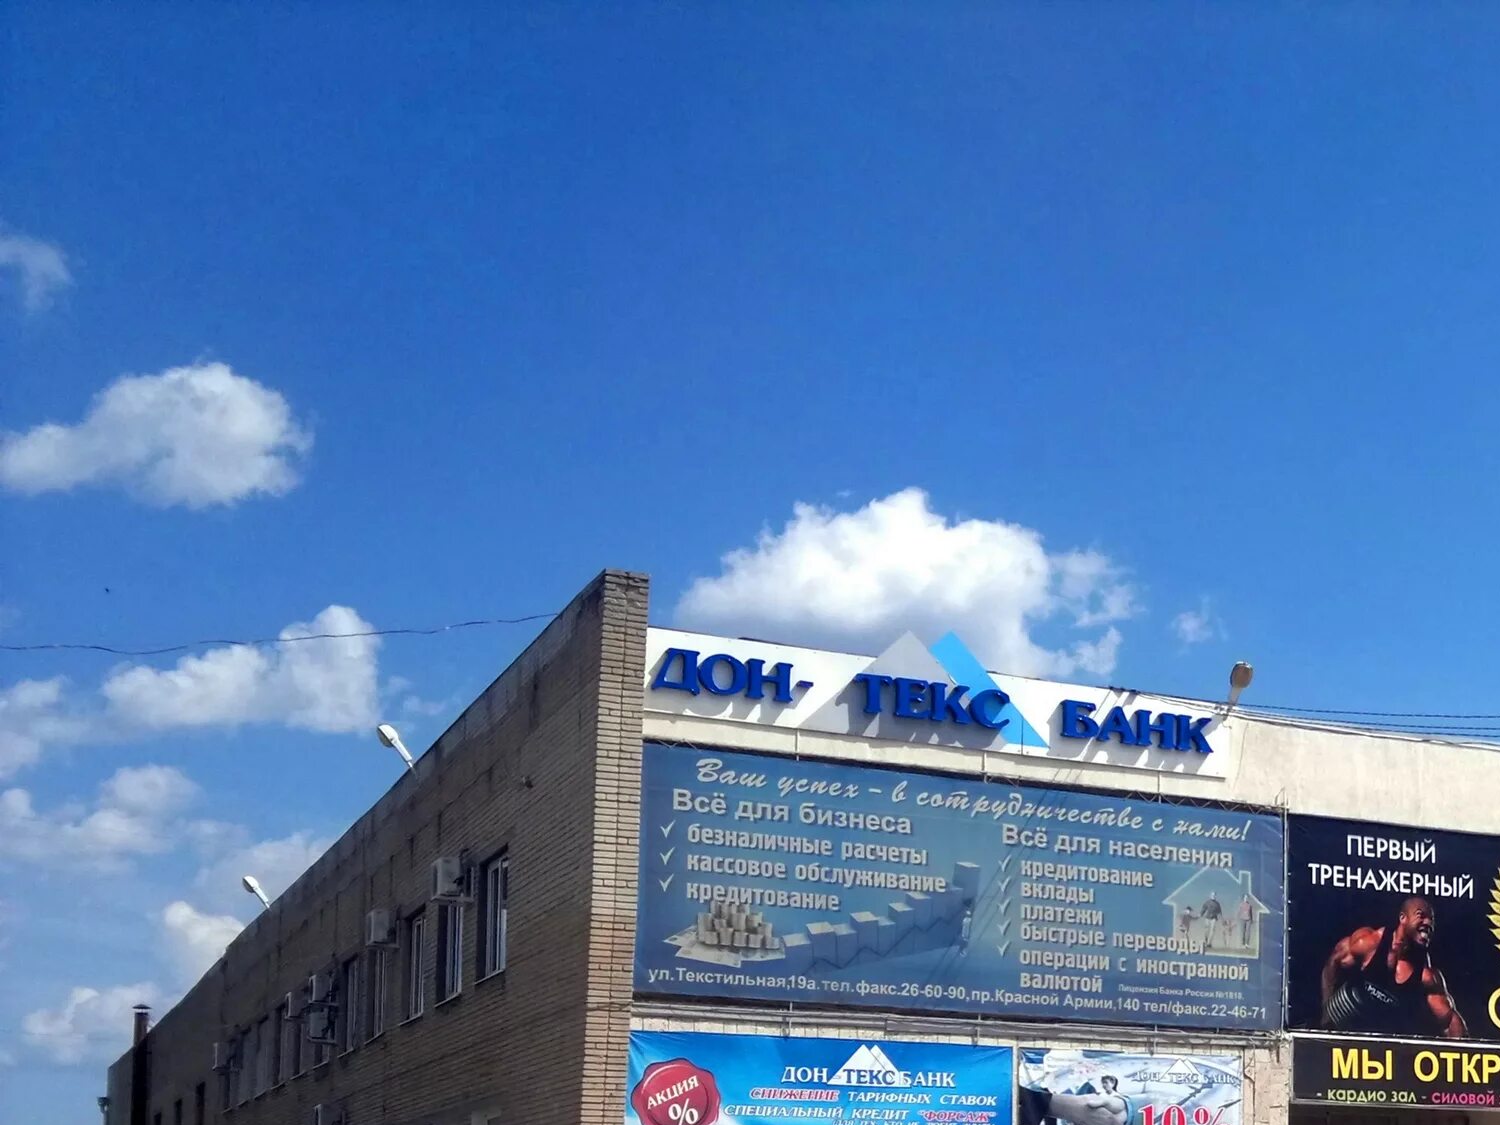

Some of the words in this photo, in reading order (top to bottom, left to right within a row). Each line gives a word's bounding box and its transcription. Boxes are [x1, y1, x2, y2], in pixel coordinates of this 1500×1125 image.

[652, 647, 812, 703] ДОН-
[855, 672, 1010, 731] ТЕКС
[1060, 699, 1214, 754] БАНК
[672, 788, 728, 816] Всё
[735, 800, 789, 822] для
[799, 802, 913, 835] бизнеса
[696, 758, 767, 788] Ваш
[777, 776, 859, 798] успех
[891, 780, 907, 803] в
[916, 790, 1143, 829] сотрудничестве
[1152, 818, 1165, 832] с
[1173, 820, 1253, 842] нами!
[687, 823, 832, 857] безналичные
[841, 840, 928, 866] расчеты
[1002, 823, 1048, 848] Всё
[1054, 833, 1101, 855] для
[1109, 839, 1234, 868] населения
[1347, 834, 1436, 864] ПЕРВЫЙ
[687, 853, 787, 878] кассовое
[795, 863, 947, 893] обслуживание
[1020, 859, 1153, 888] кредитование
[1308, 863, 1474, 899] ТРЕНАЖЕРНЫЙ
[686, 882, 840, 911] кредитование
[1020, 882, 1094, 904] вклады
[1020, 903, 1104, 926] платежи
[1020, 924, 1106, 948] быстрые
[1113, 931, 1206, 956] переводы
[1020, 949, 1110, 973] операции
[1118, 958, 1127, 972] с
[1136, 957, 1250, 981] иностранной
[1020, 972, 1103, 993] валютой
[1332, 1047, 1393, 1080] МЫ
[647, 1075, 700, 1110] АКЦИЯ
[750, 1087, 839, 1102] СНИЖЕНИЕ
[848, 1091, 931, 1104] ТАРИФНЫХ
[939, 1095, 997, 1106] СТАВОК
[1327, 1088, 1387, 1104] кардио
[1391, 1091, 1417, 1103] зал
[1432, 1090, 1495, 1105] силовой
[724, 1104, 843, 1119] СПЕЦИАЛЬНЫЙ
[852, 1109, 909, 1120] КРЕДИТ
[918, 1110, 997, 1122] "ФОРСАЖ"
